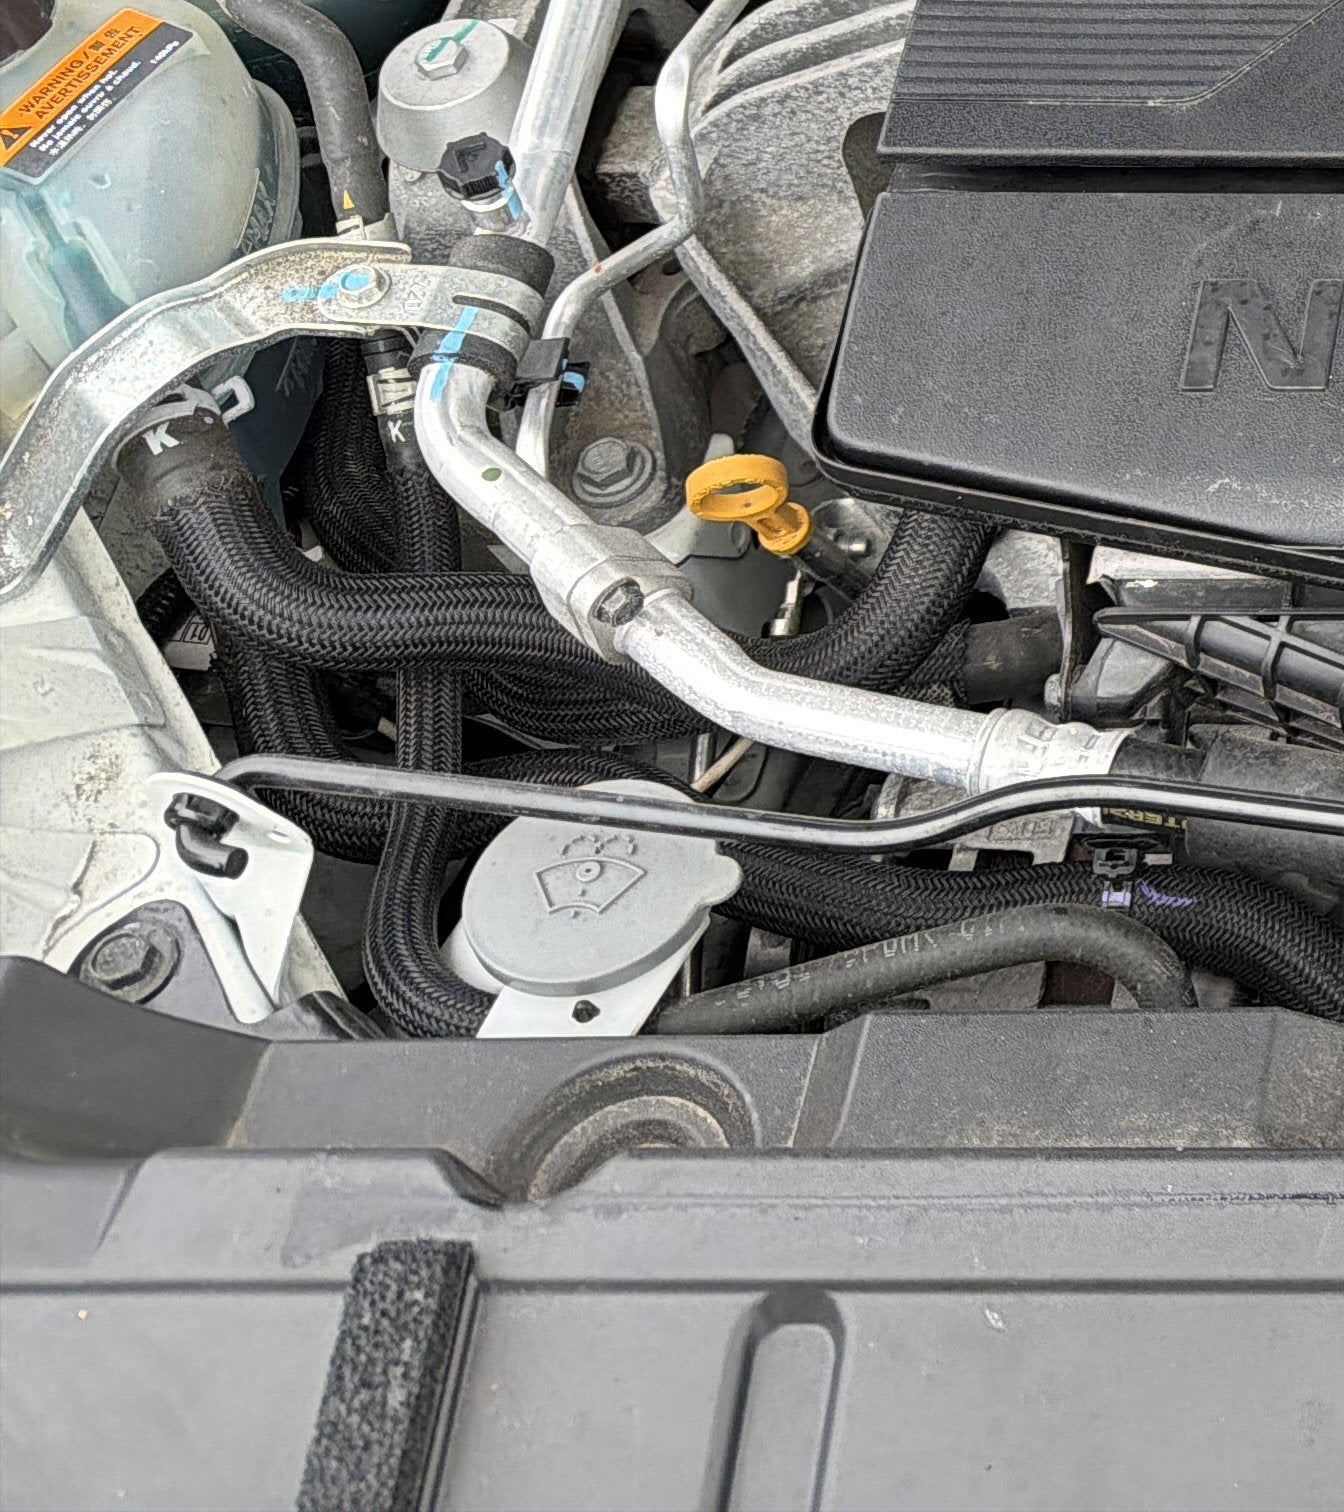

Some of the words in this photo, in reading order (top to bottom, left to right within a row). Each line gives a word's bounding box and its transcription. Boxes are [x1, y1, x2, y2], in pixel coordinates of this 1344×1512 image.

[18, 58, 85, 113] WARNING
[34, 25, 143, 120] AVERTISSEMENT
[456, 142, 487, 173] F
[143, 422, 181, 456] K
[387, 419, 406, 443] K
